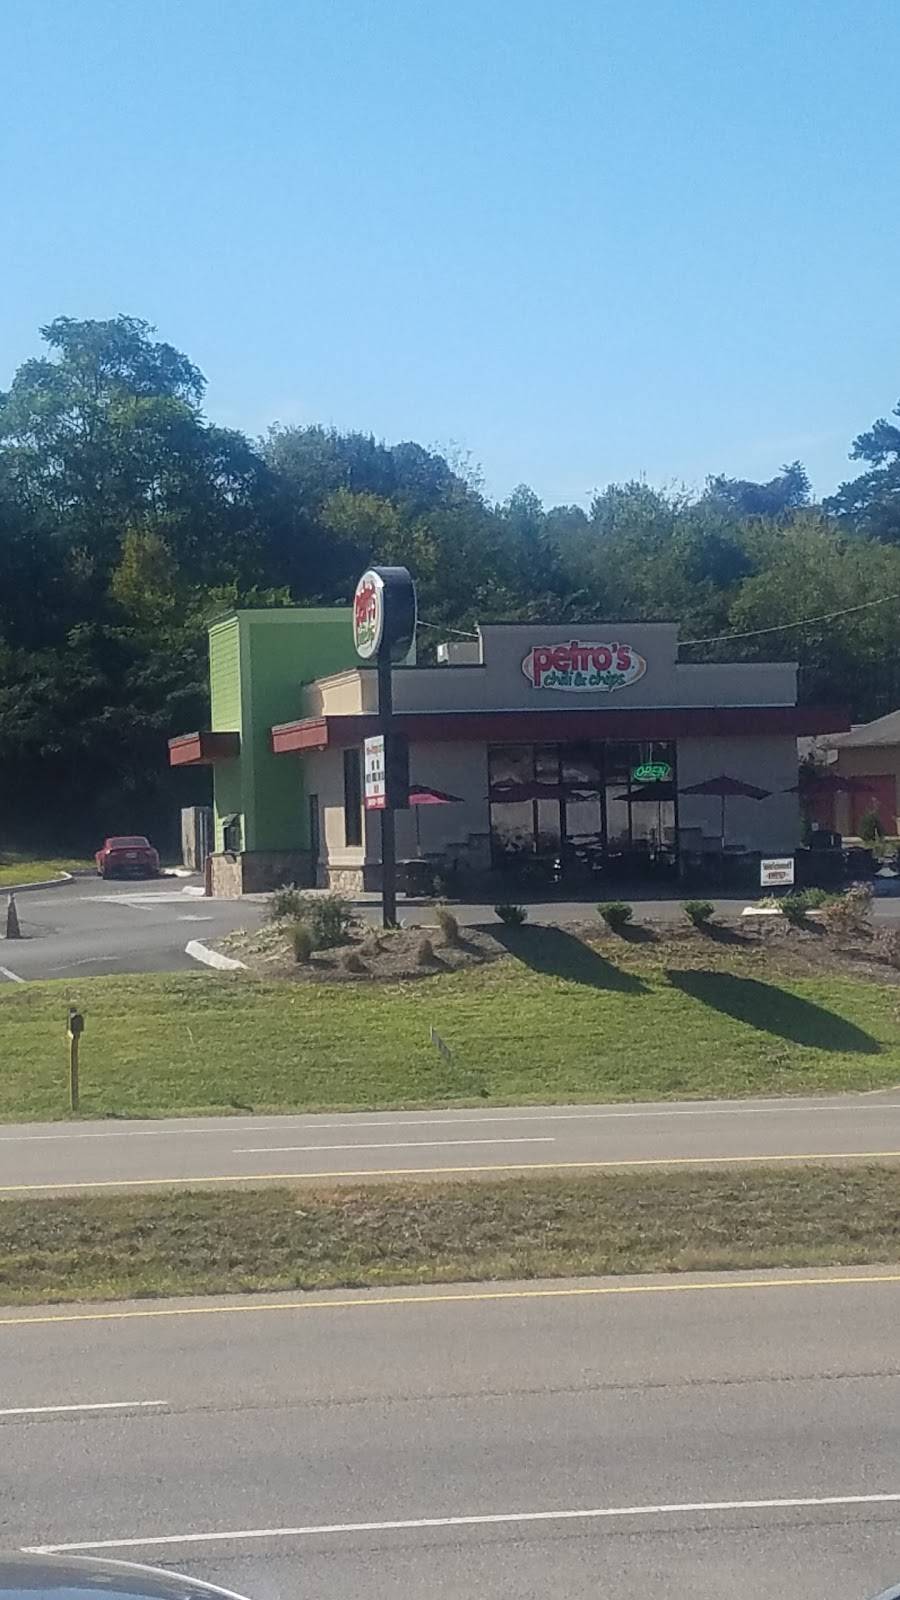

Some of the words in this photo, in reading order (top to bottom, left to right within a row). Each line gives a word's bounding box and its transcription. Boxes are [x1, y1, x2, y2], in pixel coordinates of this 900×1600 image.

[533, 641, 632, 687] petro's
[544, 671, 572, 686] chili
[574, 672, 587, 686] &
[589, 671, 626, 690] chips
[636, 765, 667, 778] OPEN
